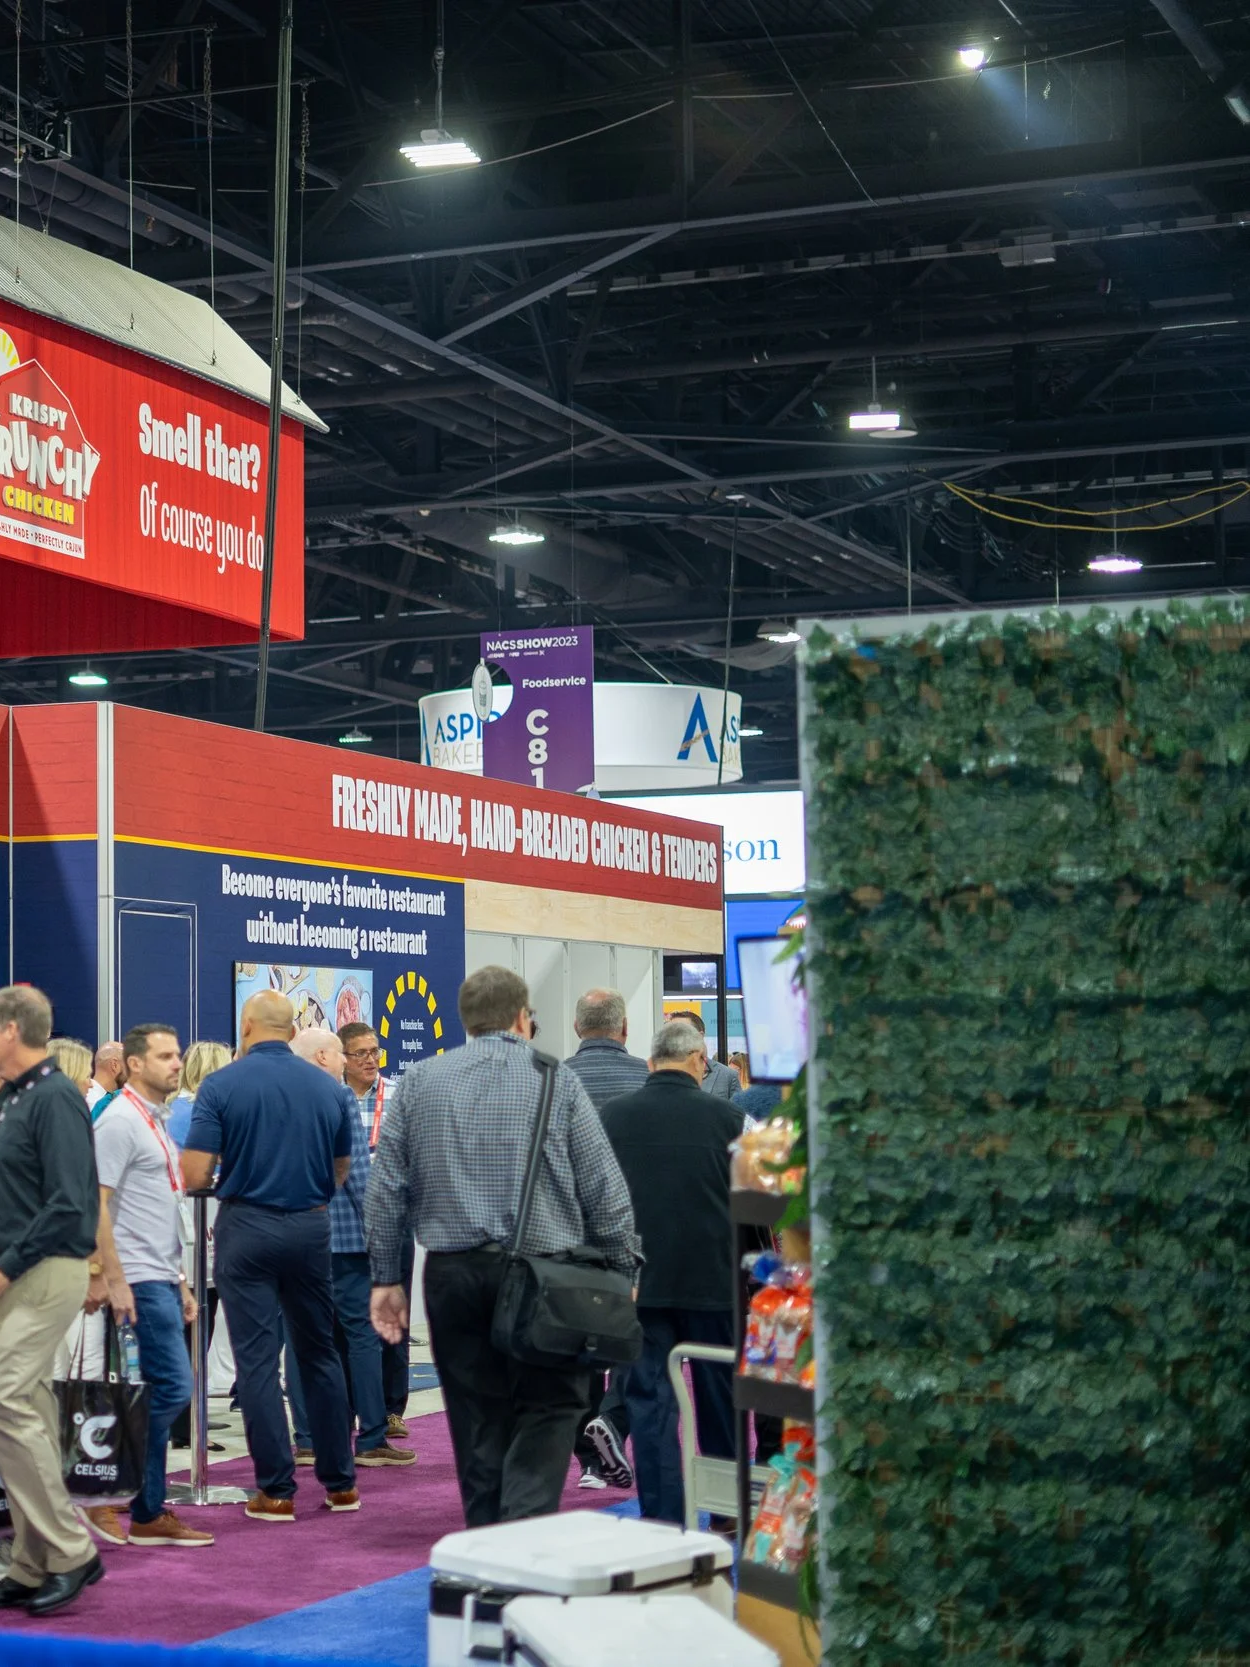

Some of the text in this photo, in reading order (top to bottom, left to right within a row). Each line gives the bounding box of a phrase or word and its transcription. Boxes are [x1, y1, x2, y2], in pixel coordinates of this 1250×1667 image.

[10, 393, 68, 431] KRISPY
[138, 402, 261, 494] Smell that?
[2, 485, 75, 525] CHICKEN
[139, 481, 264, 574] Of course you do
[13, 526, 29, 540] MADE
[34, 532, 64, 549] PERFECTLY
[65, 541, 83, 554] CAJUN
[522, 675, 586, 689] Foodservice
[332, 773, 718, 884] FRESHLY MADE, HAND-BREADED CHICKEN & TENDERS
[222, 863, 274, 899] Become
[342, 874, 388, 910] favorite
[389, 886, 446, 917] restaurant
[246, 910, 428, 960] without becoming a restaurant
[75, 1463, 117, 1477] CELSIUS
